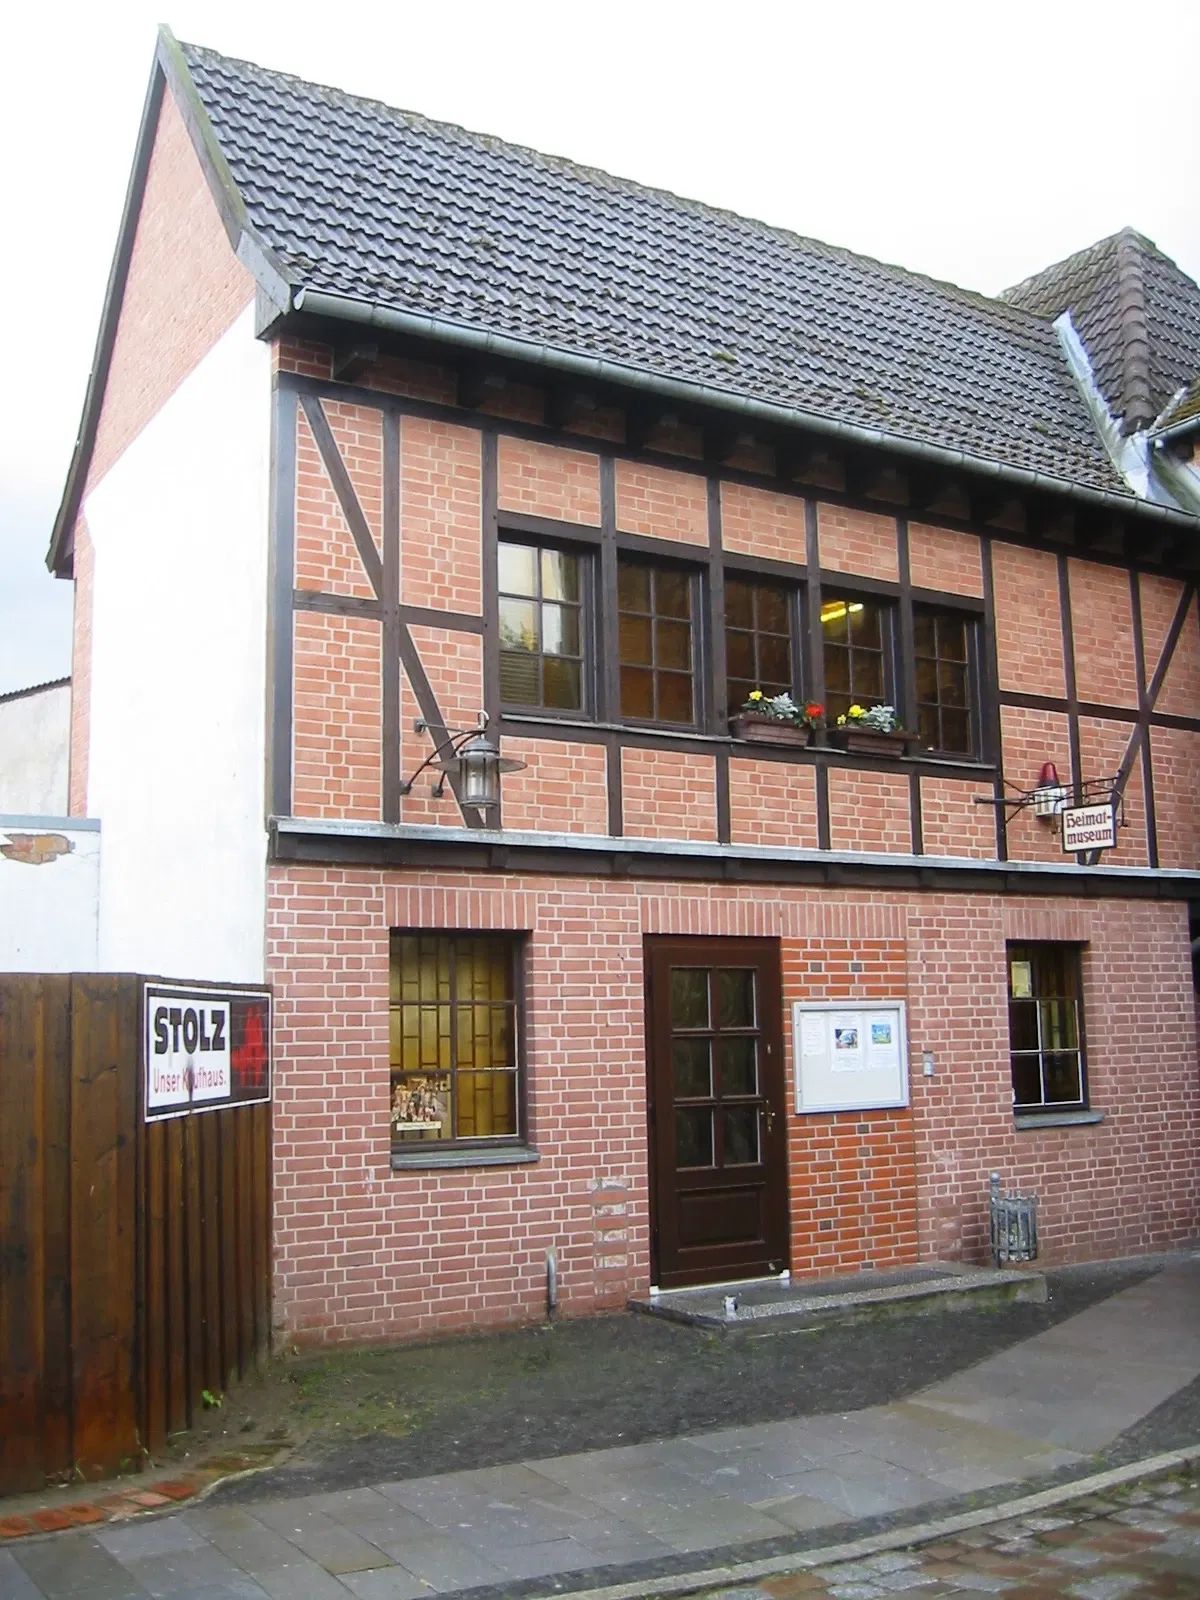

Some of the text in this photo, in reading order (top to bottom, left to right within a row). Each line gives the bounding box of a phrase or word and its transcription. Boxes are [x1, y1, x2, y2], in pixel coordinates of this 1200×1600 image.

[1066, 812, 1112, 828] Heimat-
[1067, 829, 1112, 844] museum
[154, 1006, 226, 1055] STOLZ
[153, 1066, 227, 1094] Unser Kufhaus.
